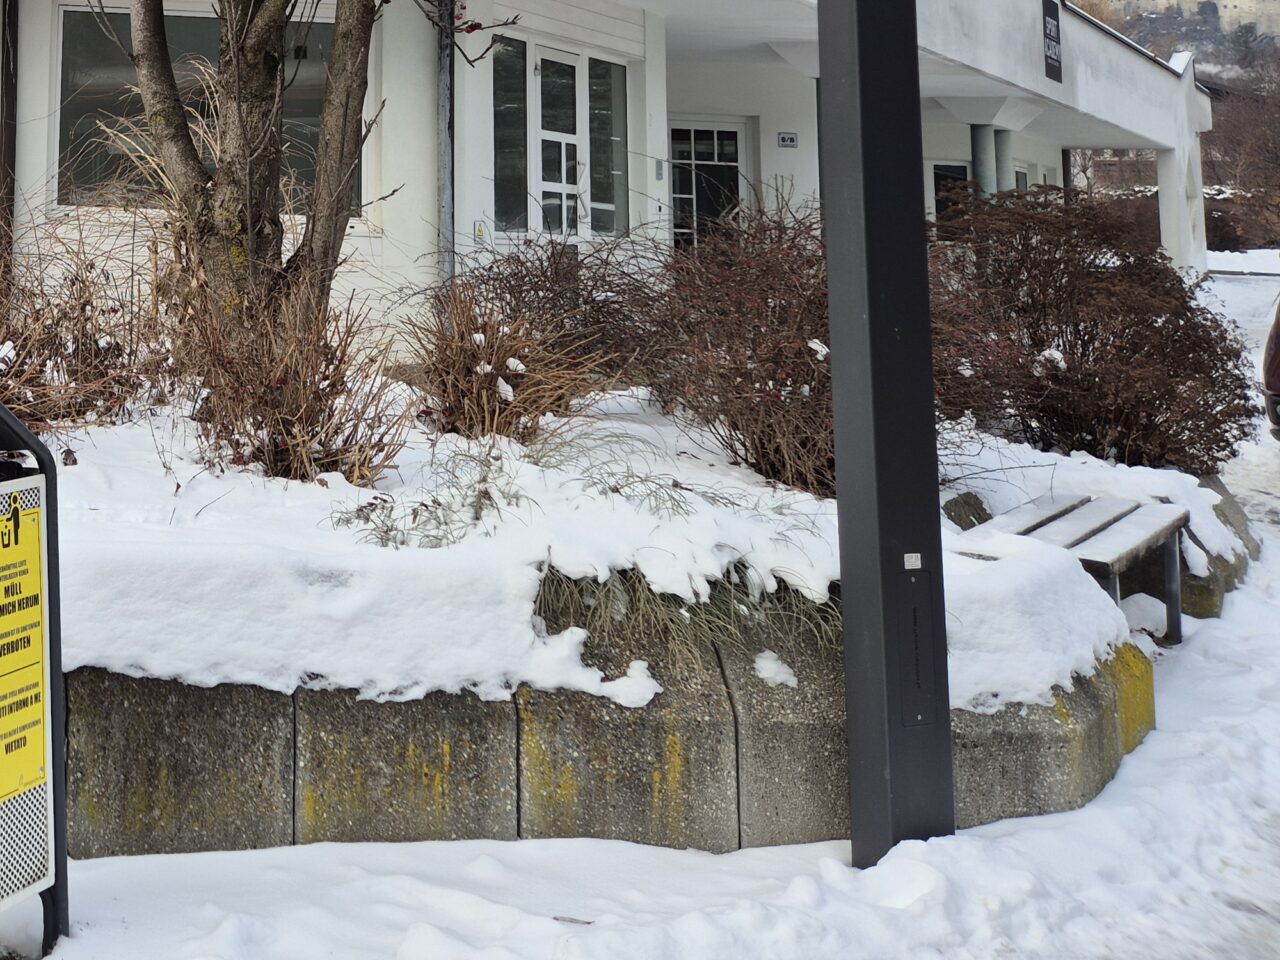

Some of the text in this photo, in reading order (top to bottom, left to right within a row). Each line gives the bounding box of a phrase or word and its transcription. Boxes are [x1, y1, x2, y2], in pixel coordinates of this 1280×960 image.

[1045, 16, 1057, 38] SPORT
[4, 582, 22, 599] MÜLL
[0, 601, 16, 617] MICH
[17, 593, 39, 611] HERUM
[7, 699, 29, 716] INTORNO
[30, 695, 34, 706] A
[35, 692, 41, 704] ME
[5, 736, 27, 755] VIETATO
